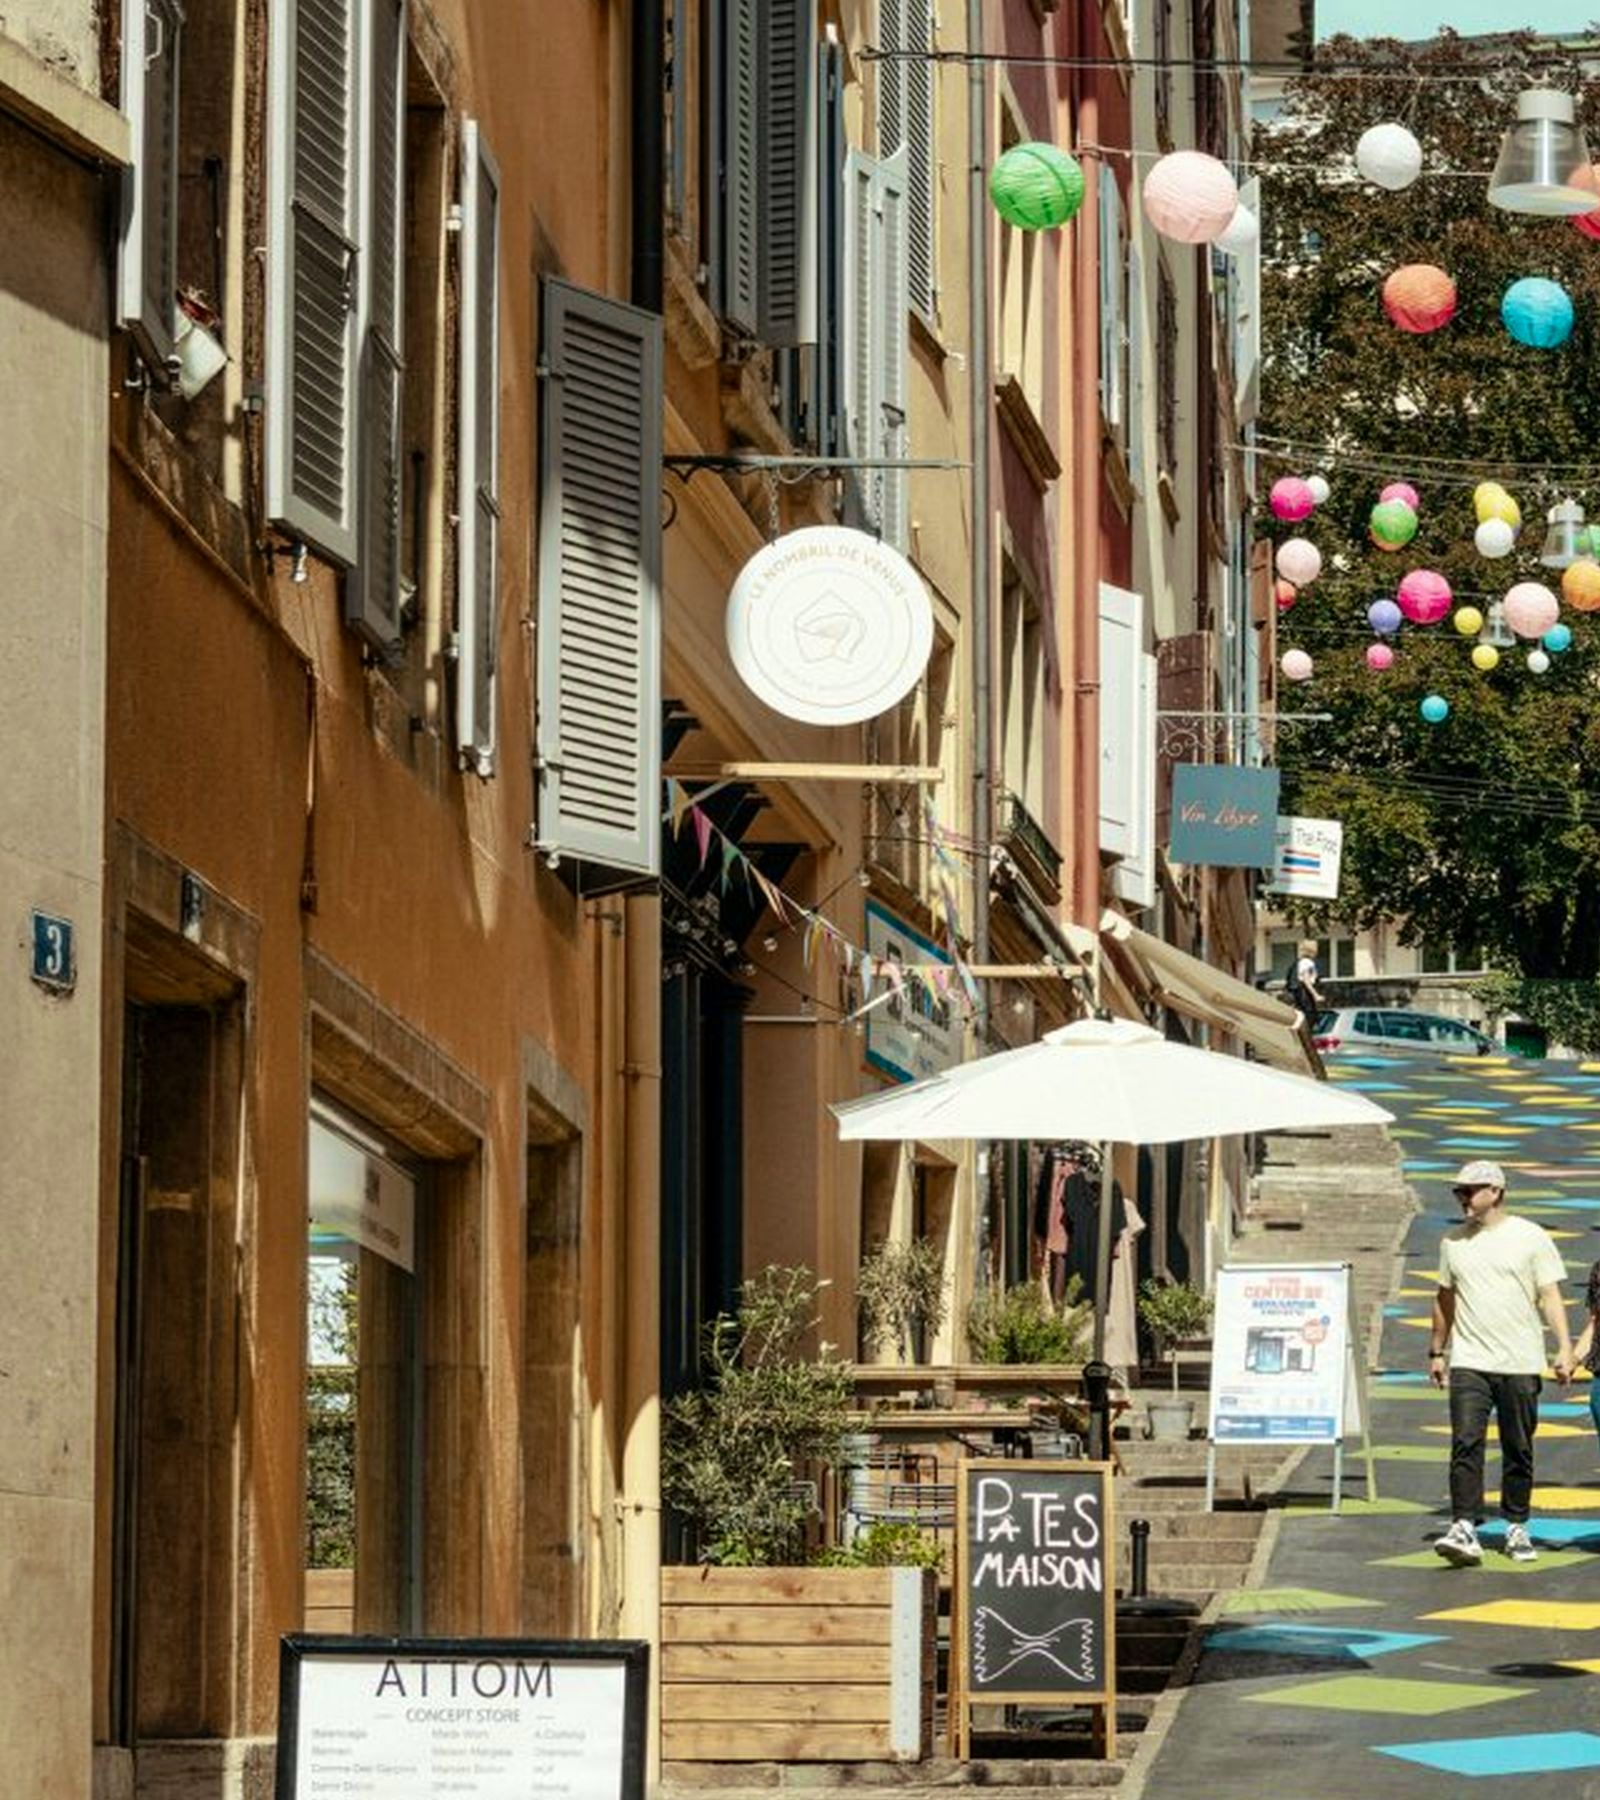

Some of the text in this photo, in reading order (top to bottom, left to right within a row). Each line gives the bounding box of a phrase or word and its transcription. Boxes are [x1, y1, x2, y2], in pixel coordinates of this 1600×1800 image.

[762, 543, 833, 582] NOMBRIL
[837, 544, 860, 561] DE
[863, 553, 907, 597] VENUS
[46, 924, 63, 976] 3
[972, 1552, 1103, 1592] MAISON
[375, 1658, 553, 1699] ATTOM
[405, 1707, 521, 1724] CONCEPT STORE
